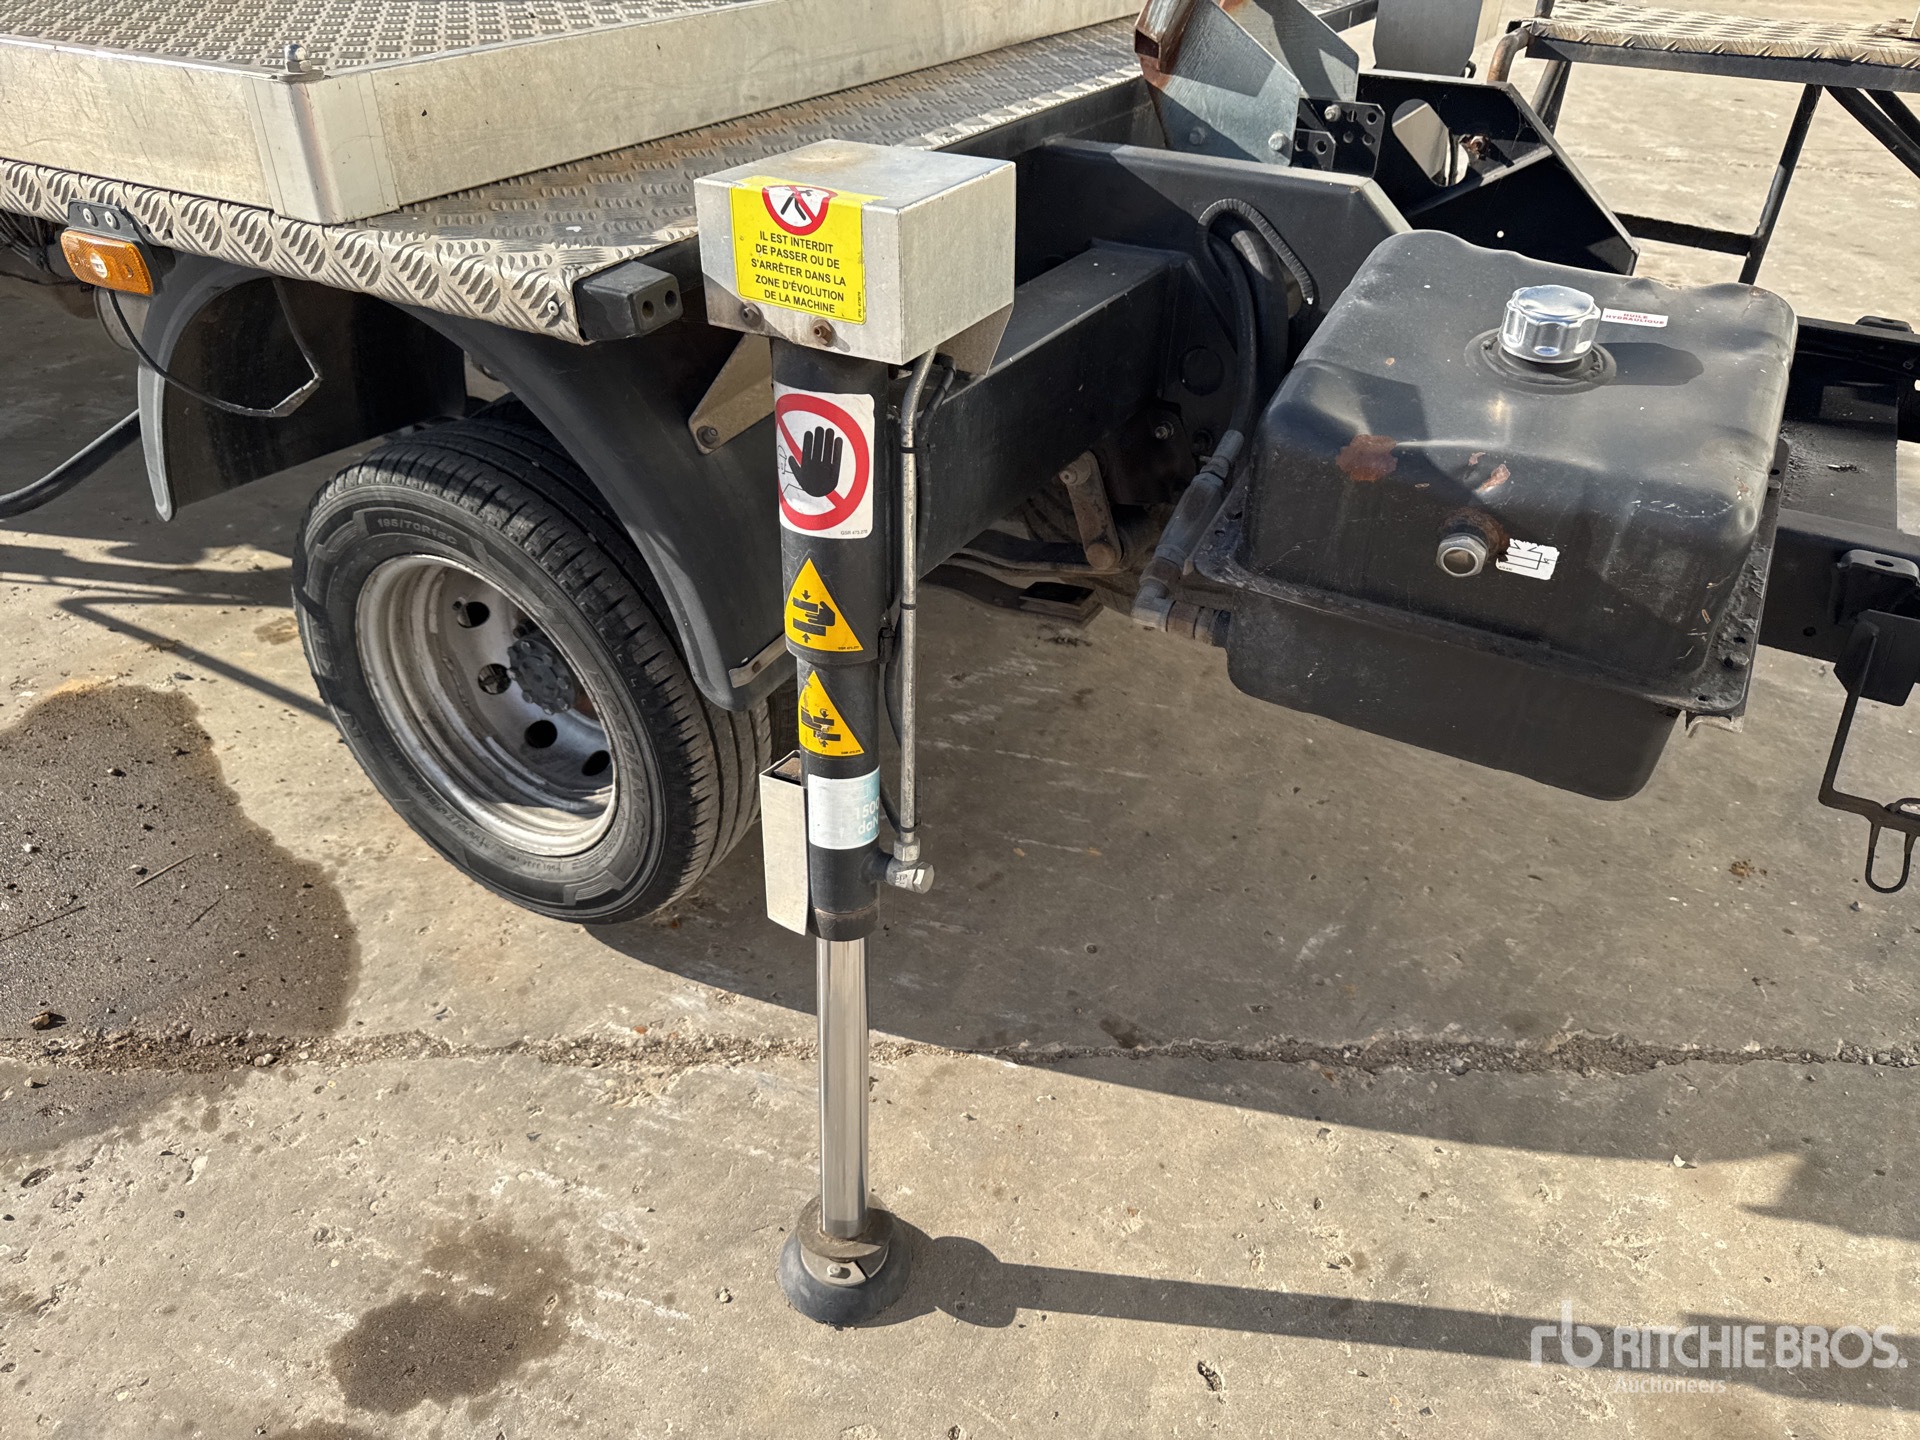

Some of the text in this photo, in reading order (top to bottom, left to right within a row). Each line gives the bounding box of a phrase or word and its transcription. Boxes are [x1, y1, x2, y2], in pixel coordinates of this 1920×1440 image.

[760, 230, 833, 254] IL EST INTERDIT
[755, 243, 840, 270] DE PASSER OU DE
[751, 258, 846, 287] S'ARRÊTER DANS LA
[755, 274, 844, 302] ZONE D'ÉVOLUTION
[764, 289, 835, 313] DE LA MACHINE
[1606, 315, 1664, 324] HYDRAULIQUE
[858, 812, 879, 835] daN
